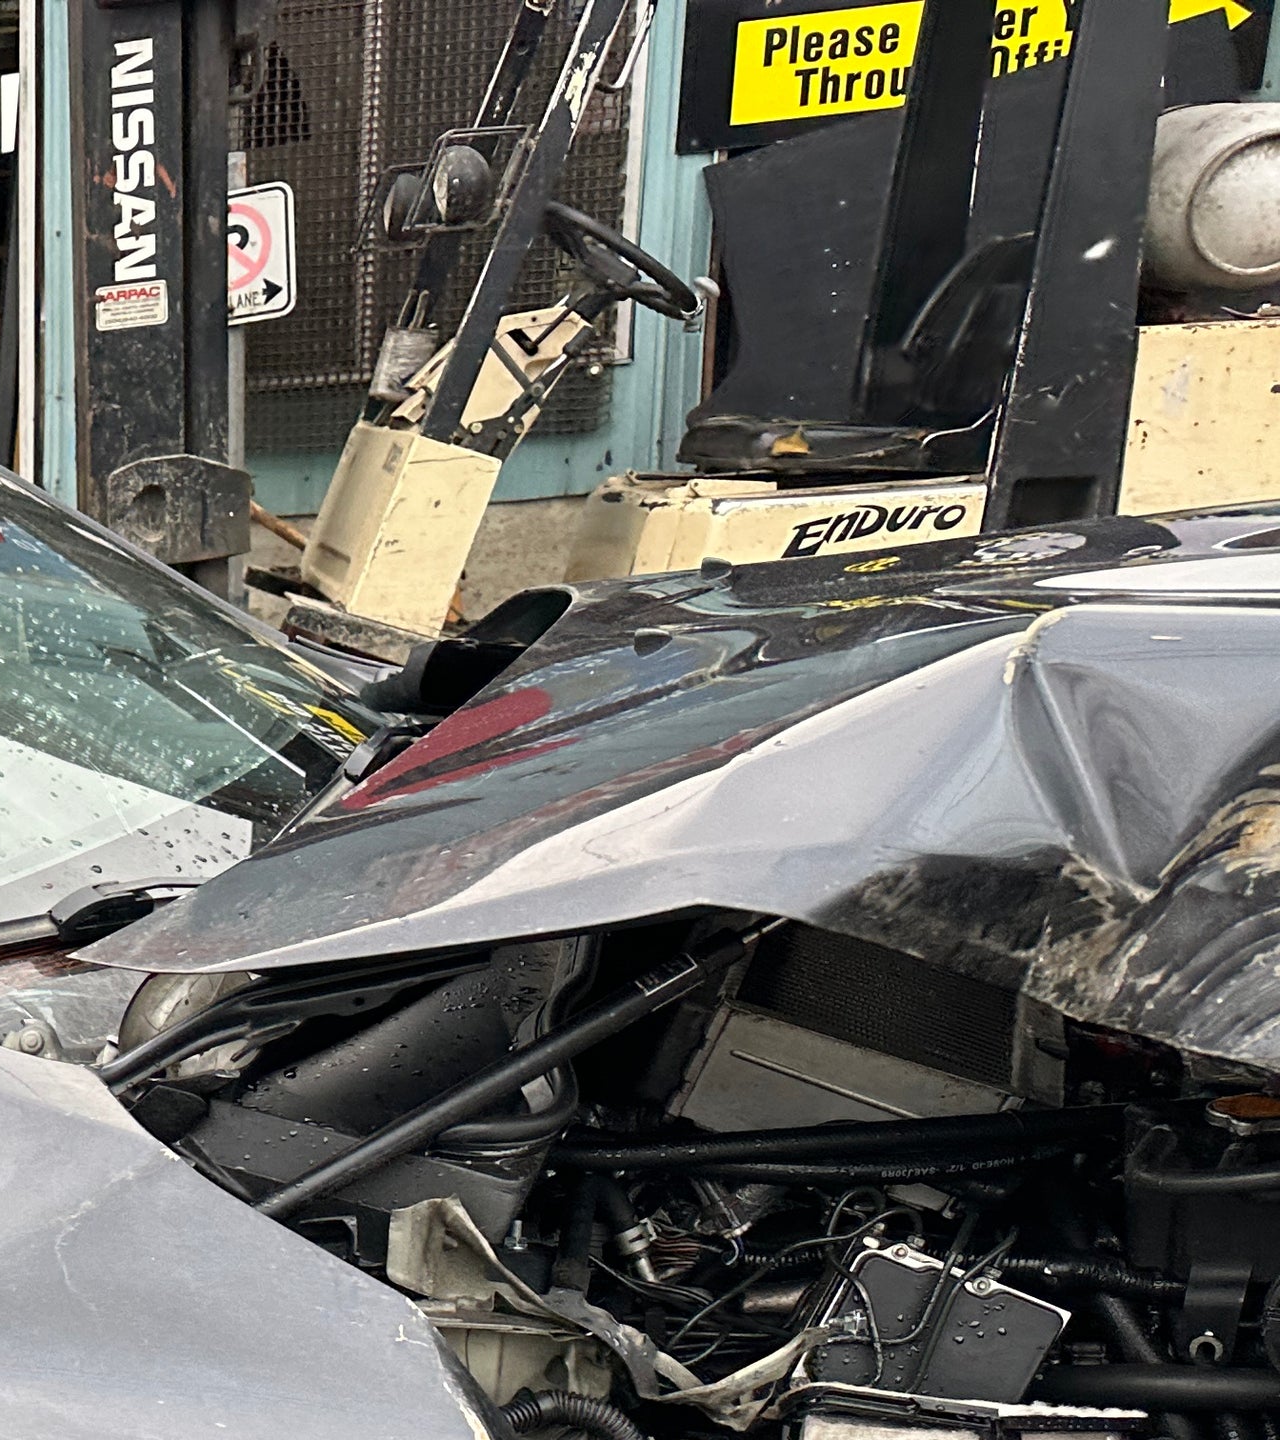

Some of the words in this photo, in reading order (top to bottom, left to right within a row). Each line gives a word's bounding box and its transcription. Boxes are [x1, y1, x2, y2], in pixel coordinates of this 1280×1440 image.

[763, 22, 900, 67] Please
[795, 66, 910, 107] Throu
[111, 38, 156, 282] NISSAN
